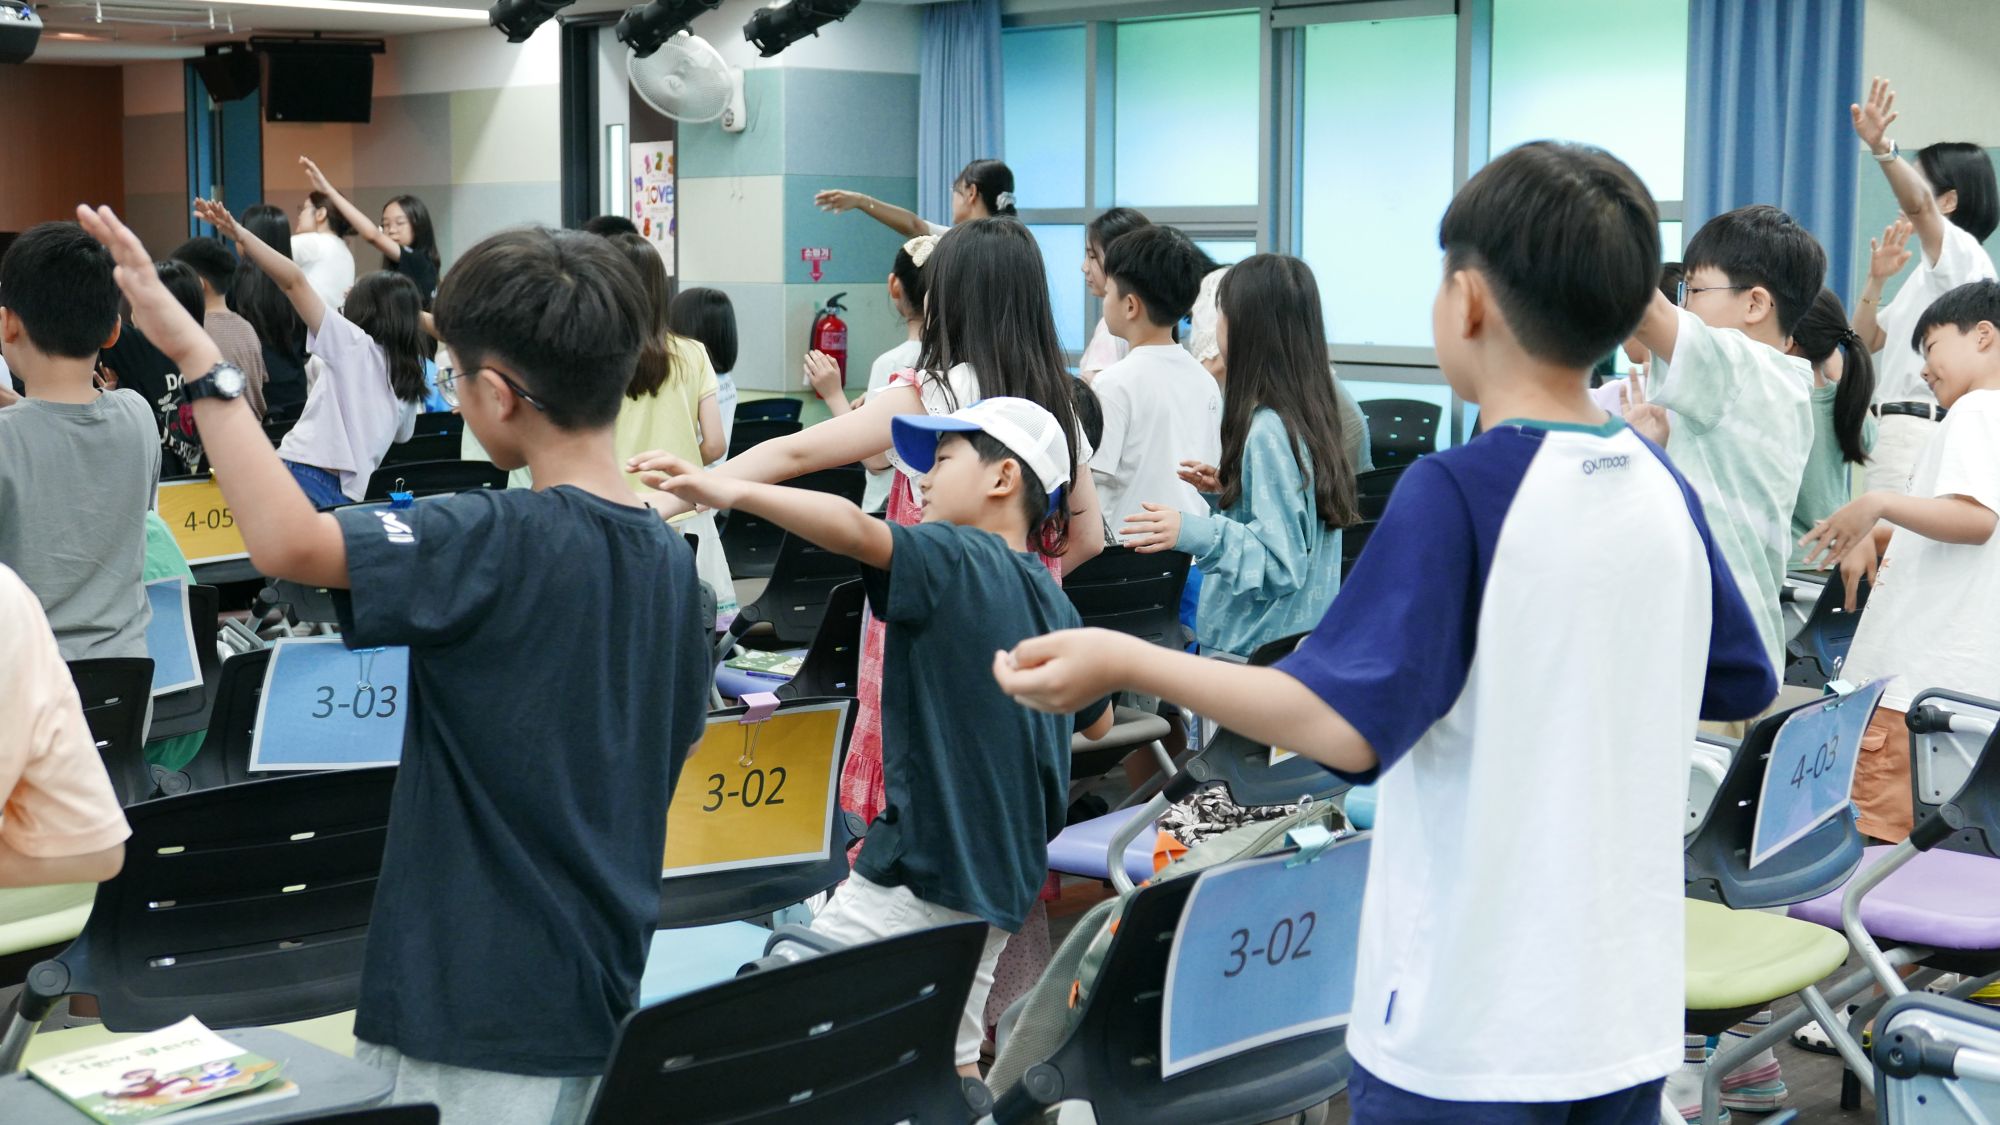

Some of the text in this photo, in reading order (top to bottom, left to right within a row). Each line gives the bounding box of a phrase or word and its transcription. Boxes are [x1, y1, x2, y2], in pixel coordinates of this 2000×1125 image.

[184, 507, 234, 532] 4-05
[312, 685, 398, 719] 3-03
[1790, 734, 1839, 789] 4-03
[702, 767, 787, 812] 3-02
[1223, 911, 1316, 978] 3-02
